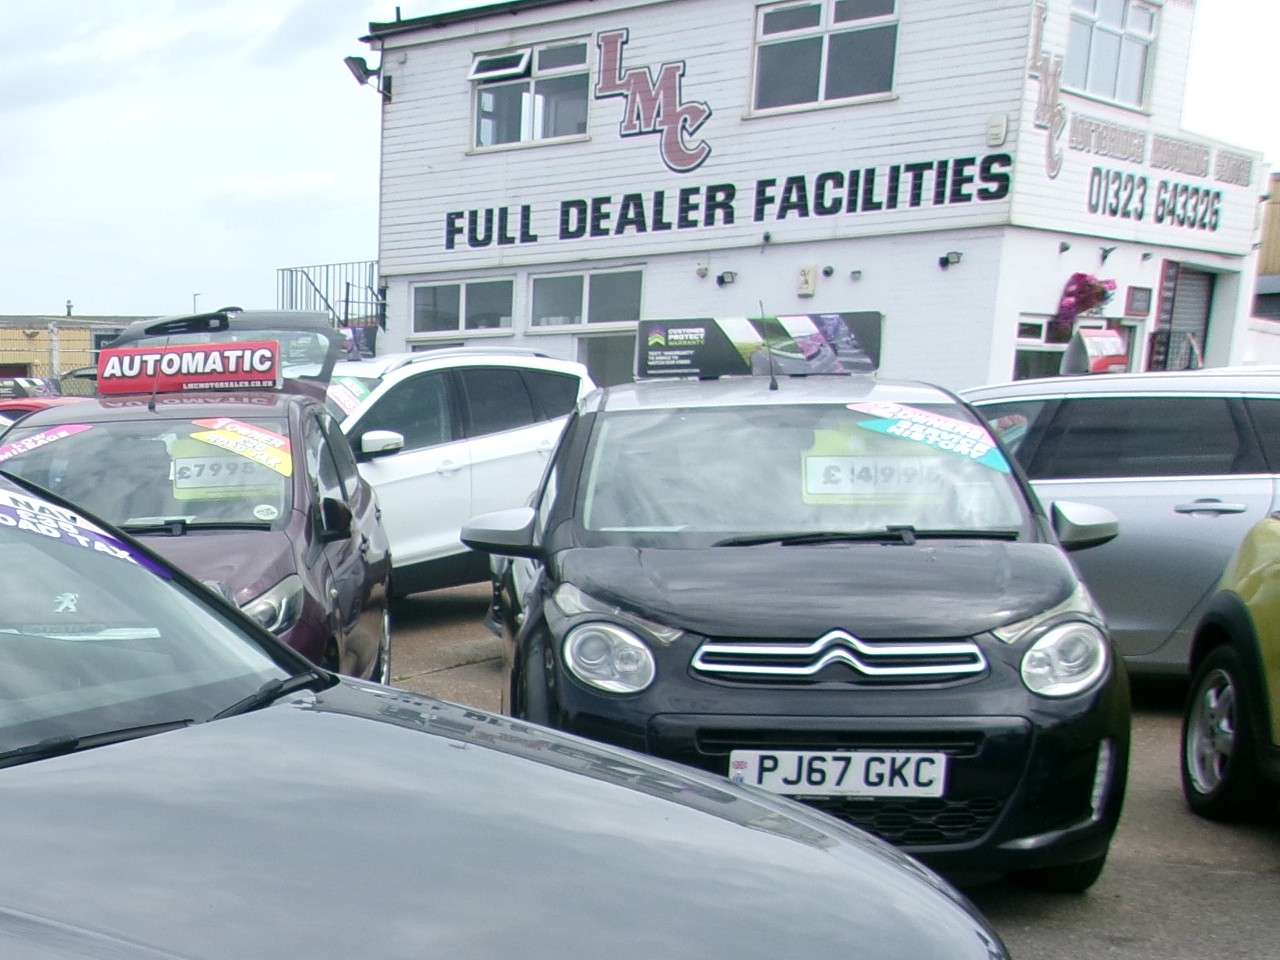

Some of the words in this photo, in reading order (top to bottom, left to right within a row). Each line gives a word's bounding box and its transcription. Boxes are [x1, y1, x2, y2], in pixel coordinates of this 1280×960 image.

[595, 27, 712, 173] LMC
[445, 209, 538, 251] FULL
[558, 182, 737, 241] DEALER
[753, 152, 1014, 223] FACILITIES
[1087, 166, 1147, 223] 01323
[1152, 179, 1222, 233] 643326
[102, 348, 273, 378] AUTOMATIC
[10, 497, 78, 525] NAV
[68, 533, 140, 565] TAX
[756, 754, 852, 786] PJ67
[863, 756, 936, 787] GKC
